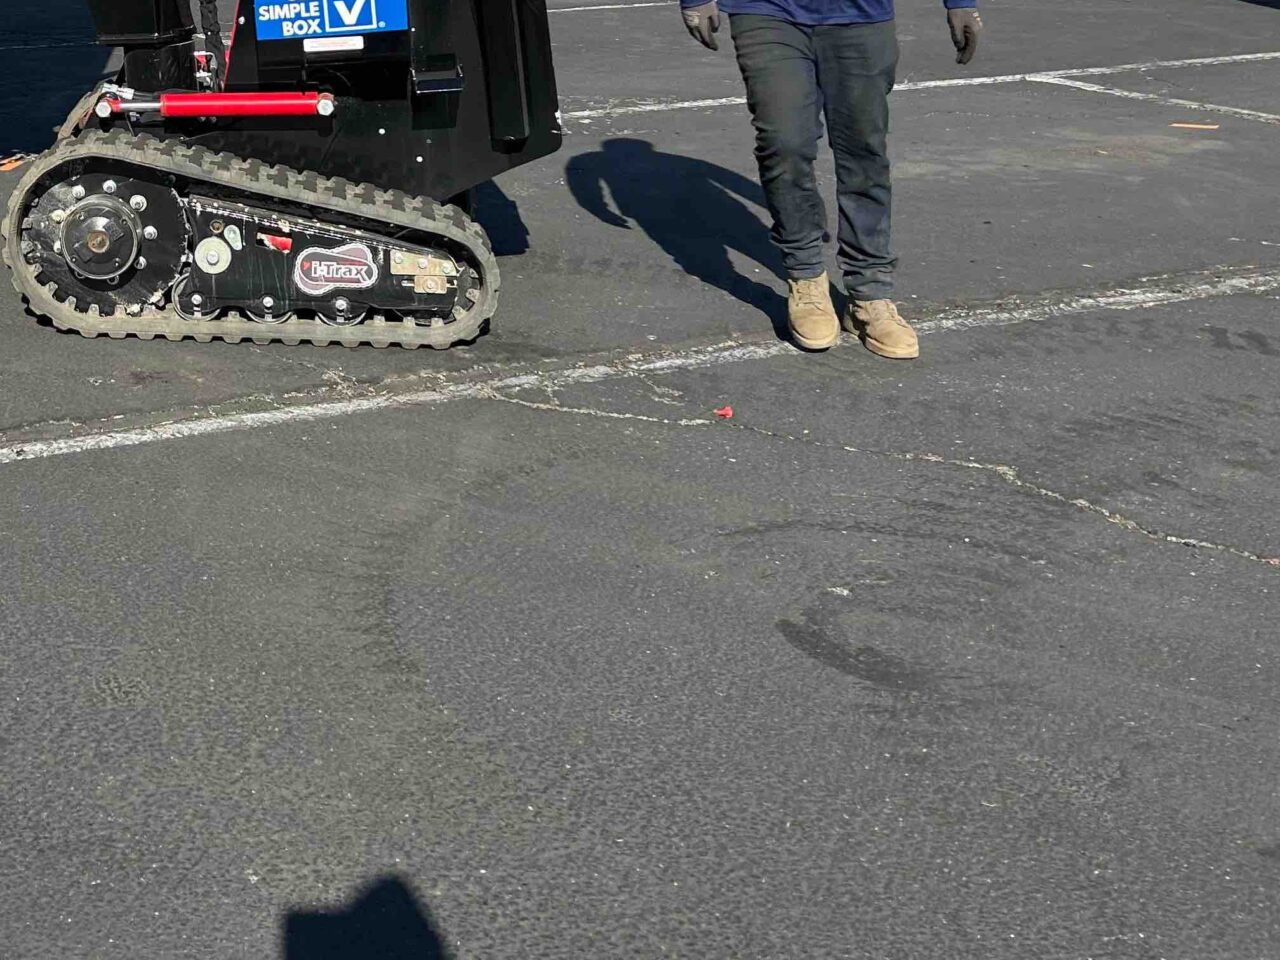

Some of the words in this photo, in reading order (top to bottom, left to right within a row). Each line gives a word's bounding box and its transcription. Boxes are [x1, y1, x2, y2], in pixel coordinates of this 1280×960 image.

[258, 1, 320, 21] SIMPLE
[282, 19, 323, 36] BOX
[311, 261, 370, 283] i-Trax
